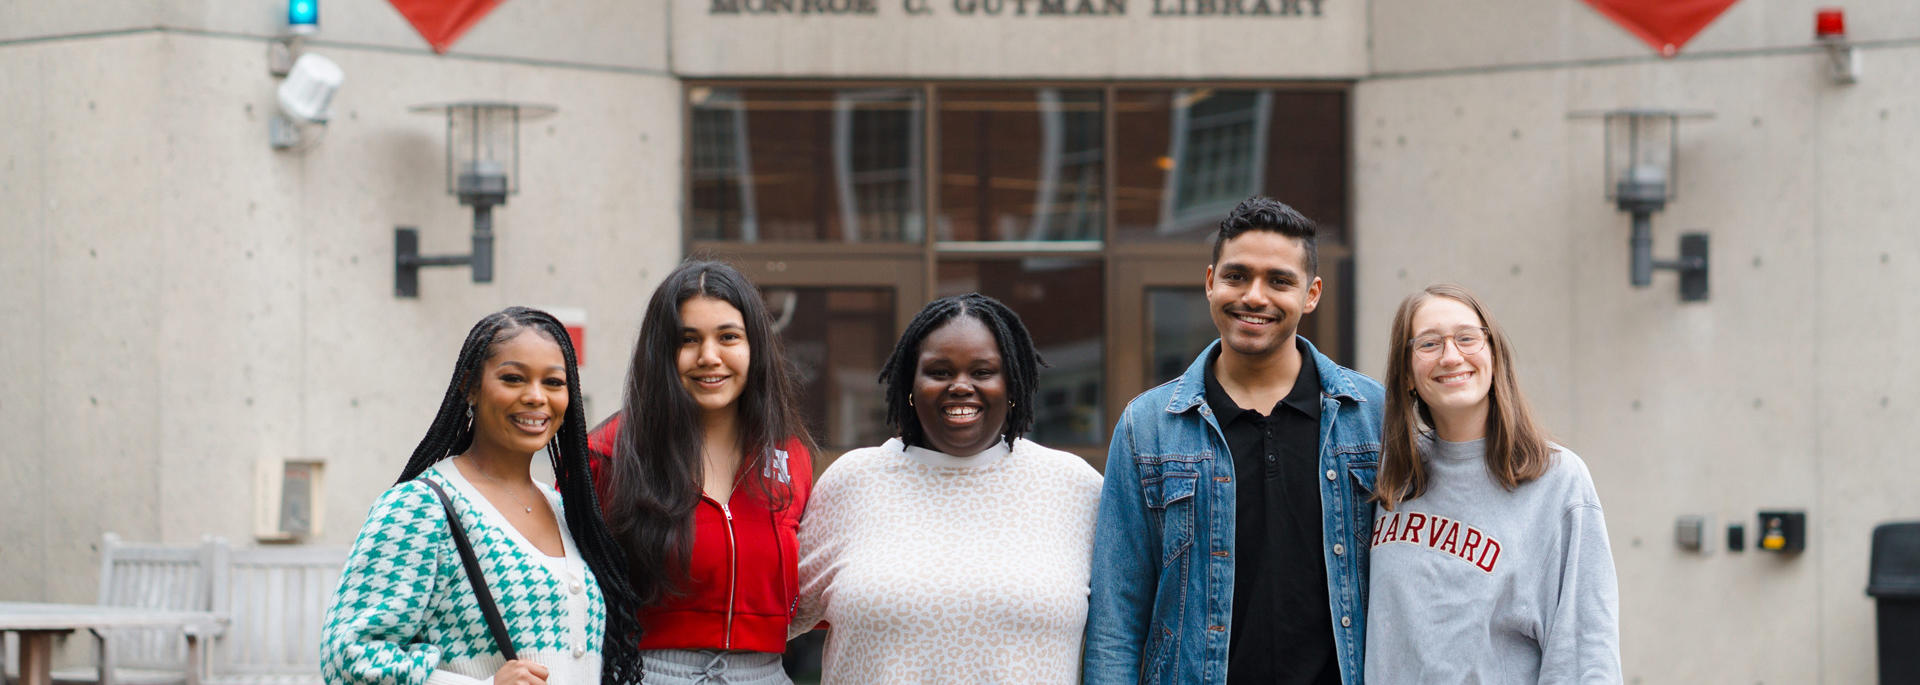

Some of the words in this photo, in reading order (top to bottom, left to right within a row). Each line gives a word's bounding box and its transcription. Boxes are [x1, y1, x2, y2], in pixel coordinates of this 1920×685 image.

[709, 0, 879, 16] MONROE
[952, 0, 1127, 16] GUTMAN
[1152, 0, 1324, 16] LIBRARY
[1370, 512, 1501, 573] HARVARD
